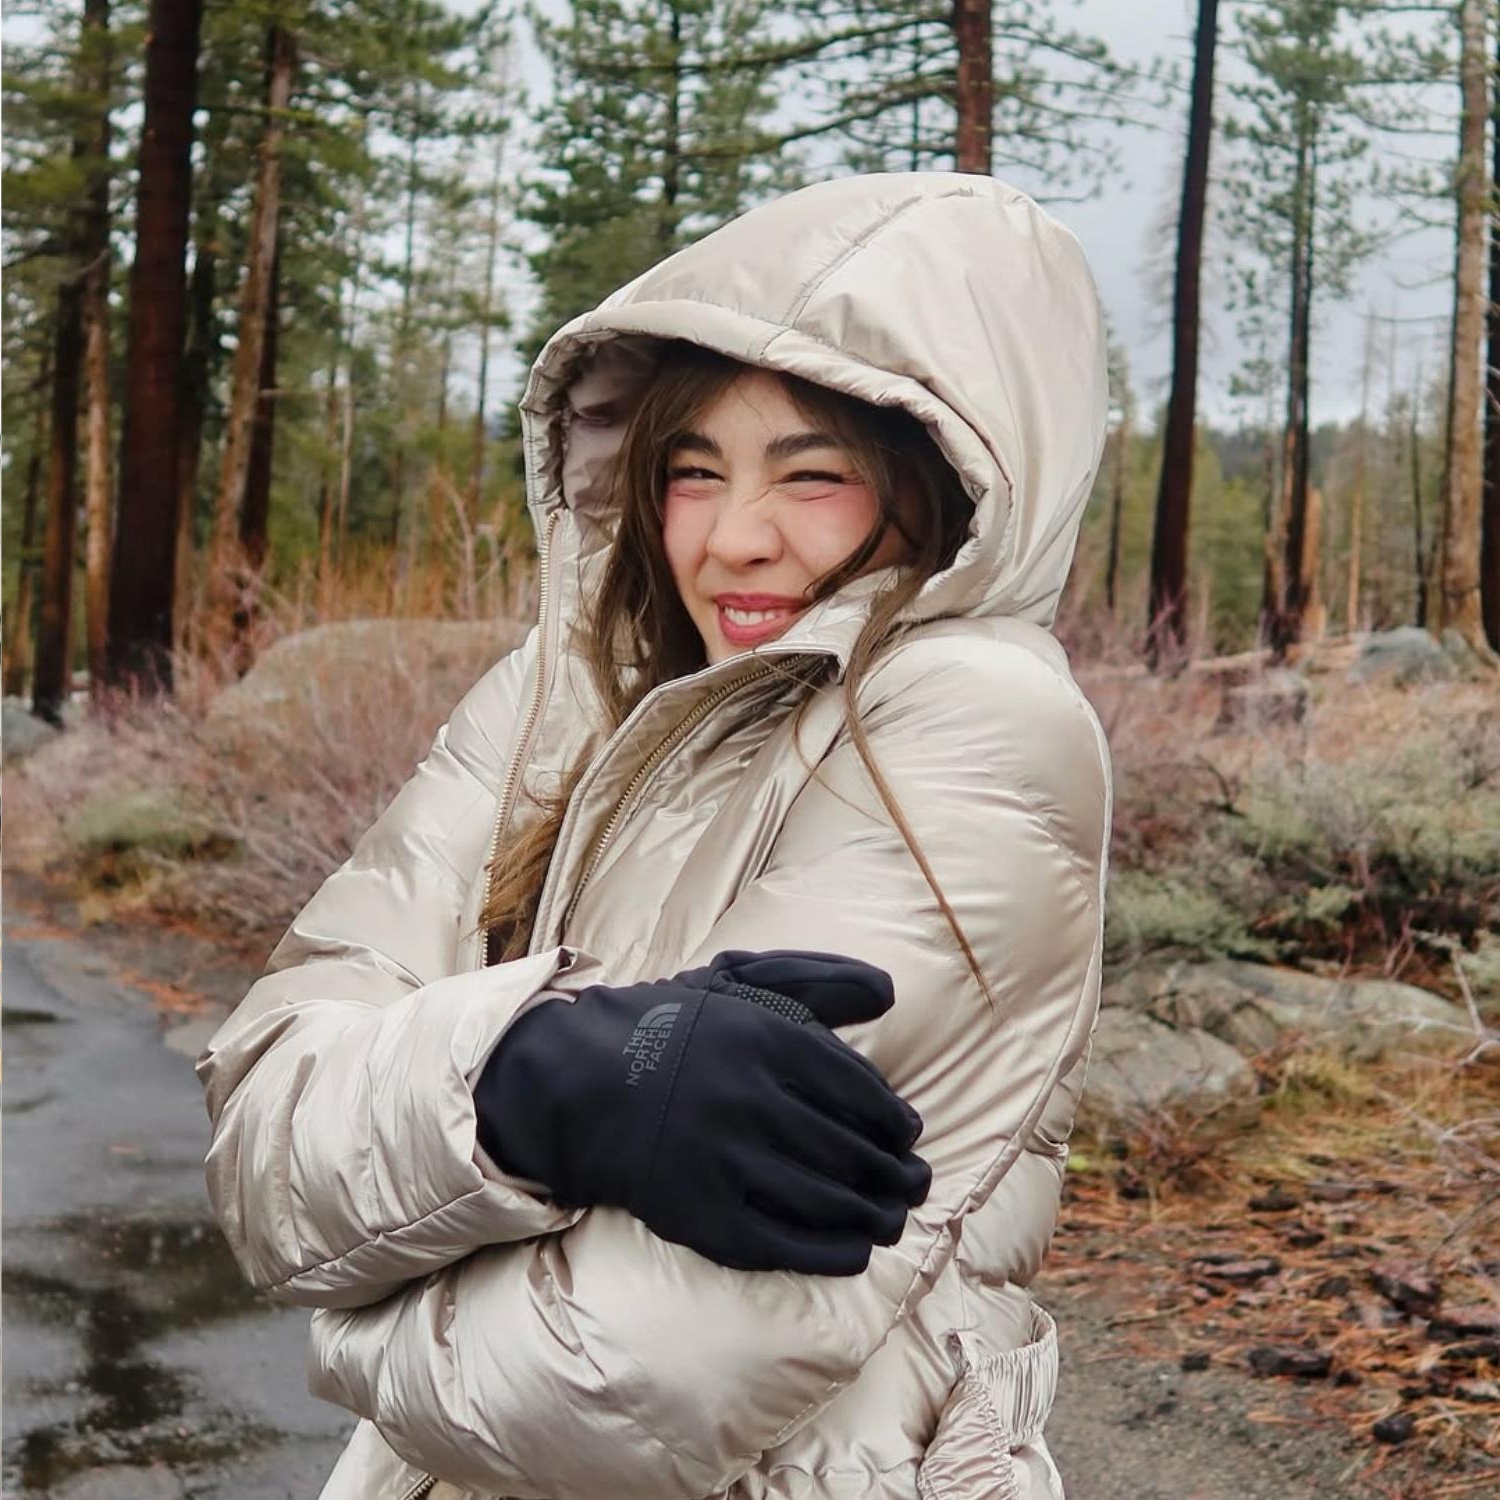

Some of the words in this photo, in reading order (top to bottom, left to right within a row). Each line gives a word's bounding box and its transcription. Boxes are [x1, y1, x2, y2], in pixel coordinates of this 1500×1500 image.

[622, 1028, 646, 1056] THE
[625, 1028, 660, 1086] NORTH
[645, 1029, 672, 1071] FACE
